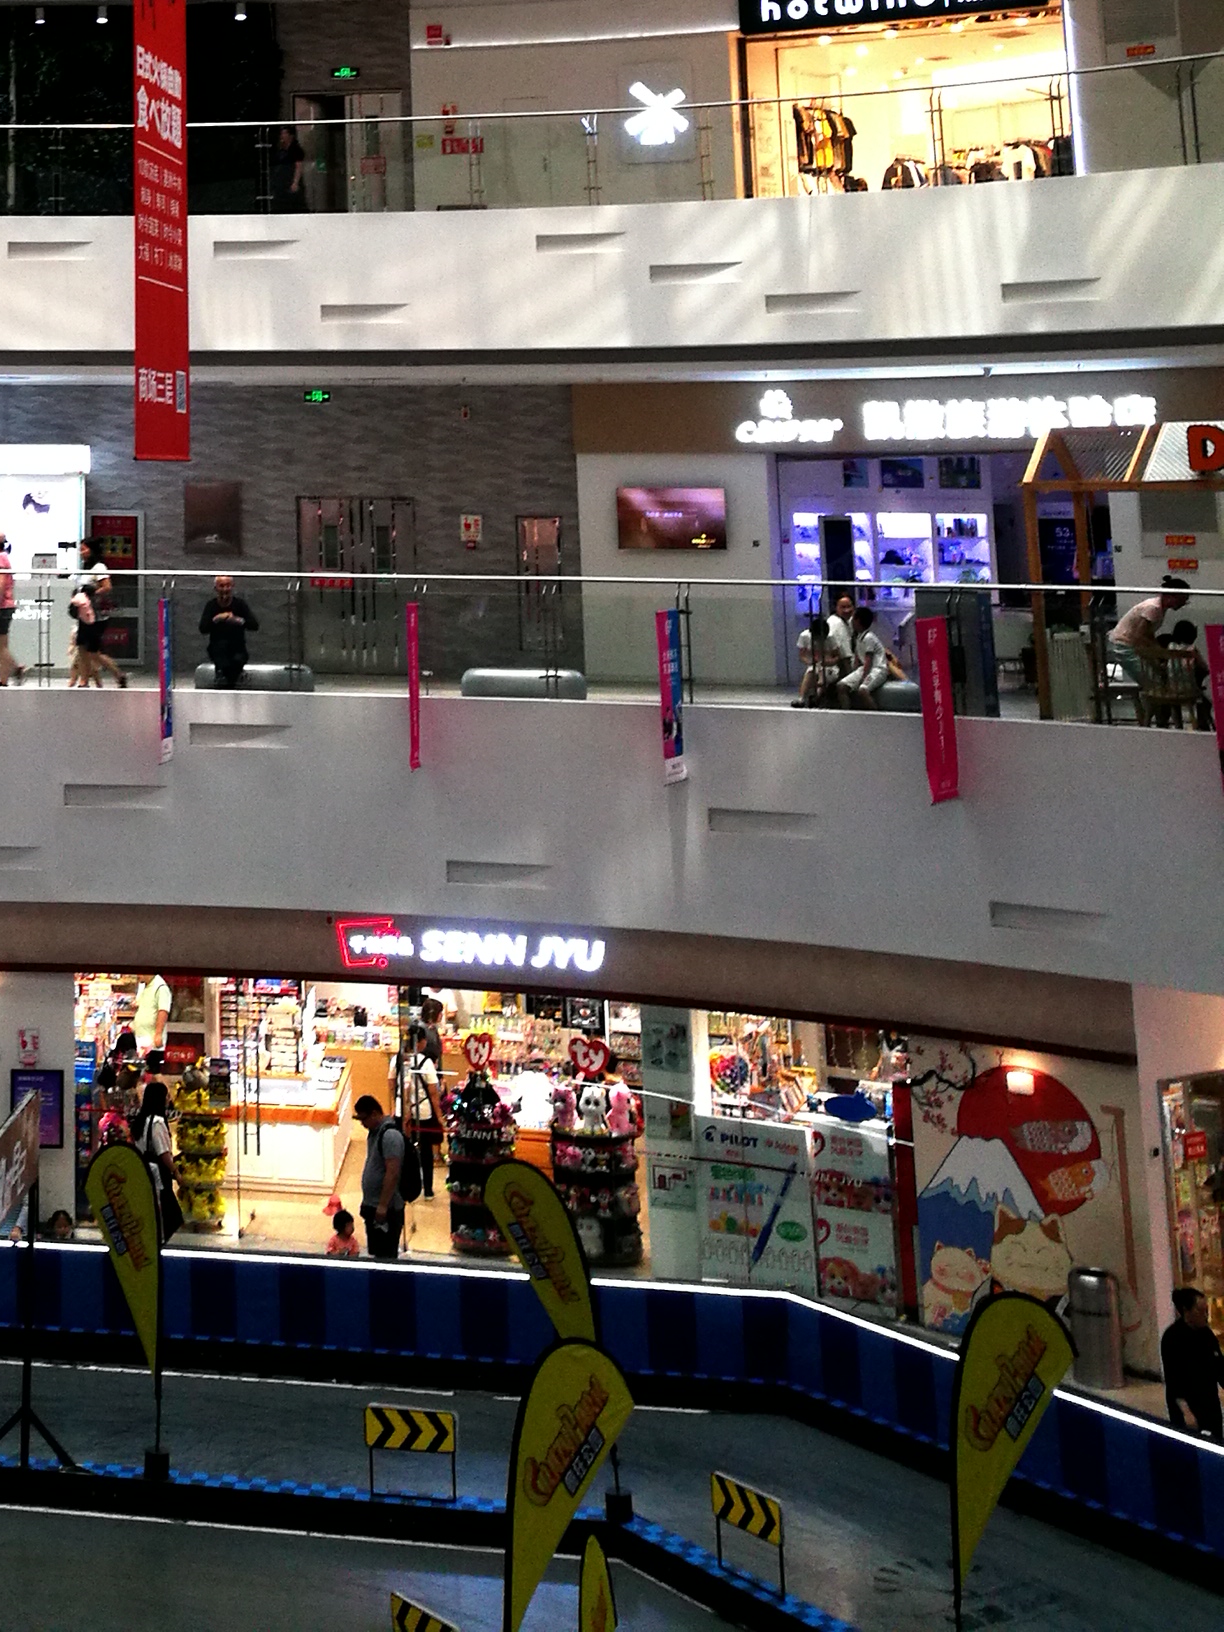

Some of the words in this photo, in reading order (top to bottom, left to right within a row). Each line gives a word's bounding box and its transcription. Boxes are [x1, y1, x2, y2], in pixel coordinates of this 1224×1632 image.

[419, 929, 529, 967] SENN
[530, 936, 607, 972] JYU
[467, 1038, 491, 1066] ty
[571, 1040, 605, 1072] ty
[720, 1133, 759, 1149] PILOT
